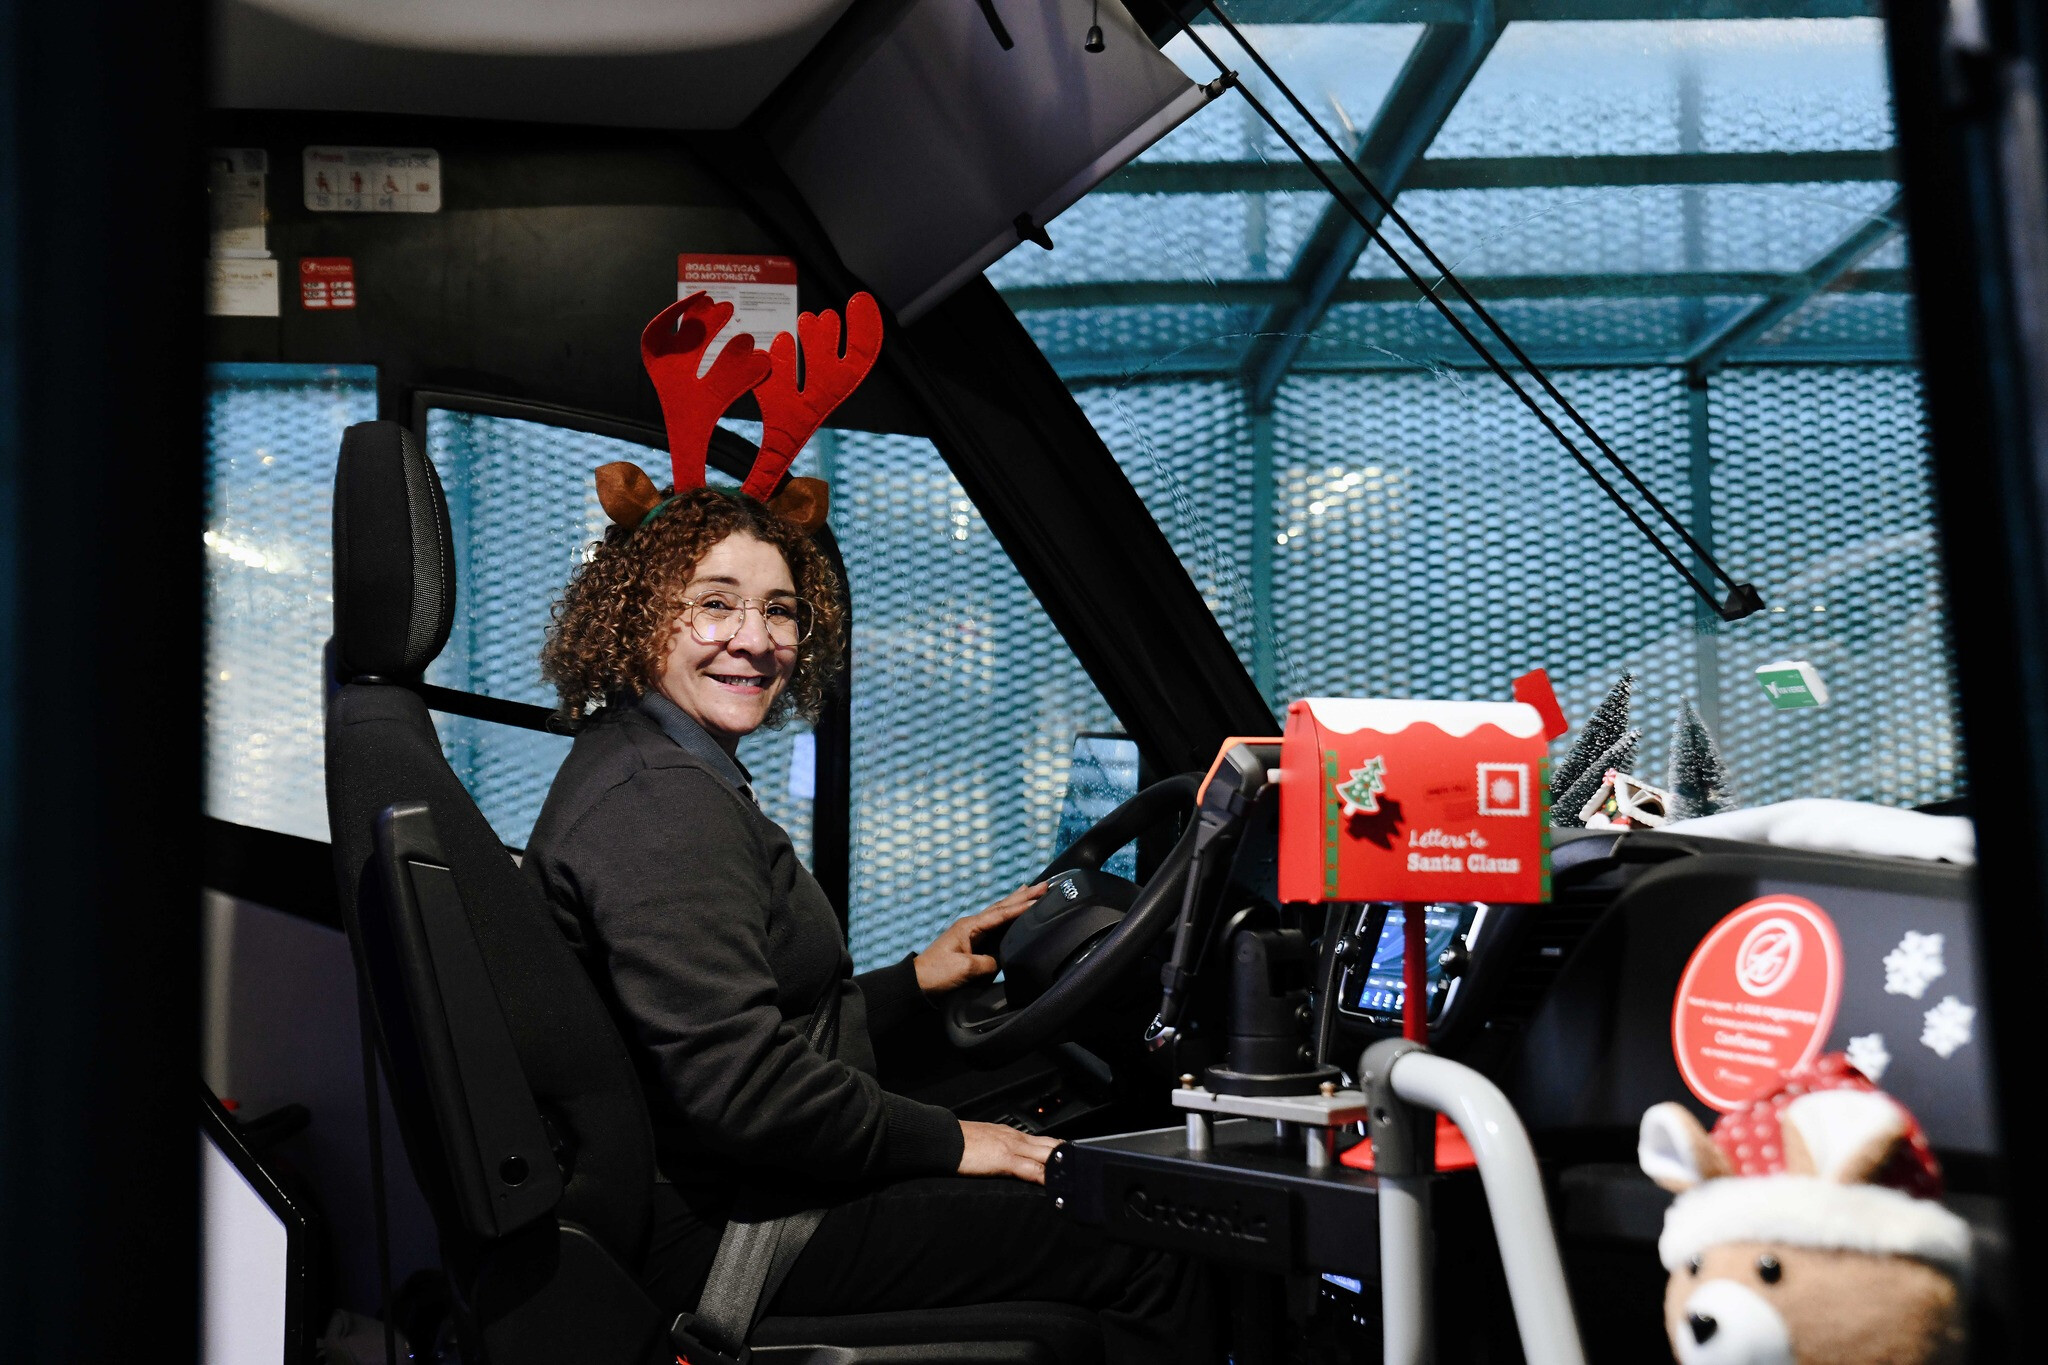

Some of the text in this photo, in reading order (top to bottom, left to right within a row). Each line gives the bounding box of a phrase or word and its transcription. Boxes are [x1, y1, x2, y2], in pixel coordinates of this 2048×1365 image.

[685, 263, 712, 272] BOAS
[685, 272, 757, 282] DO MOTORISTA
[1408, 829, 1488, 849] Letters to
[1407, 853, 1520, 873] Santa Claus
